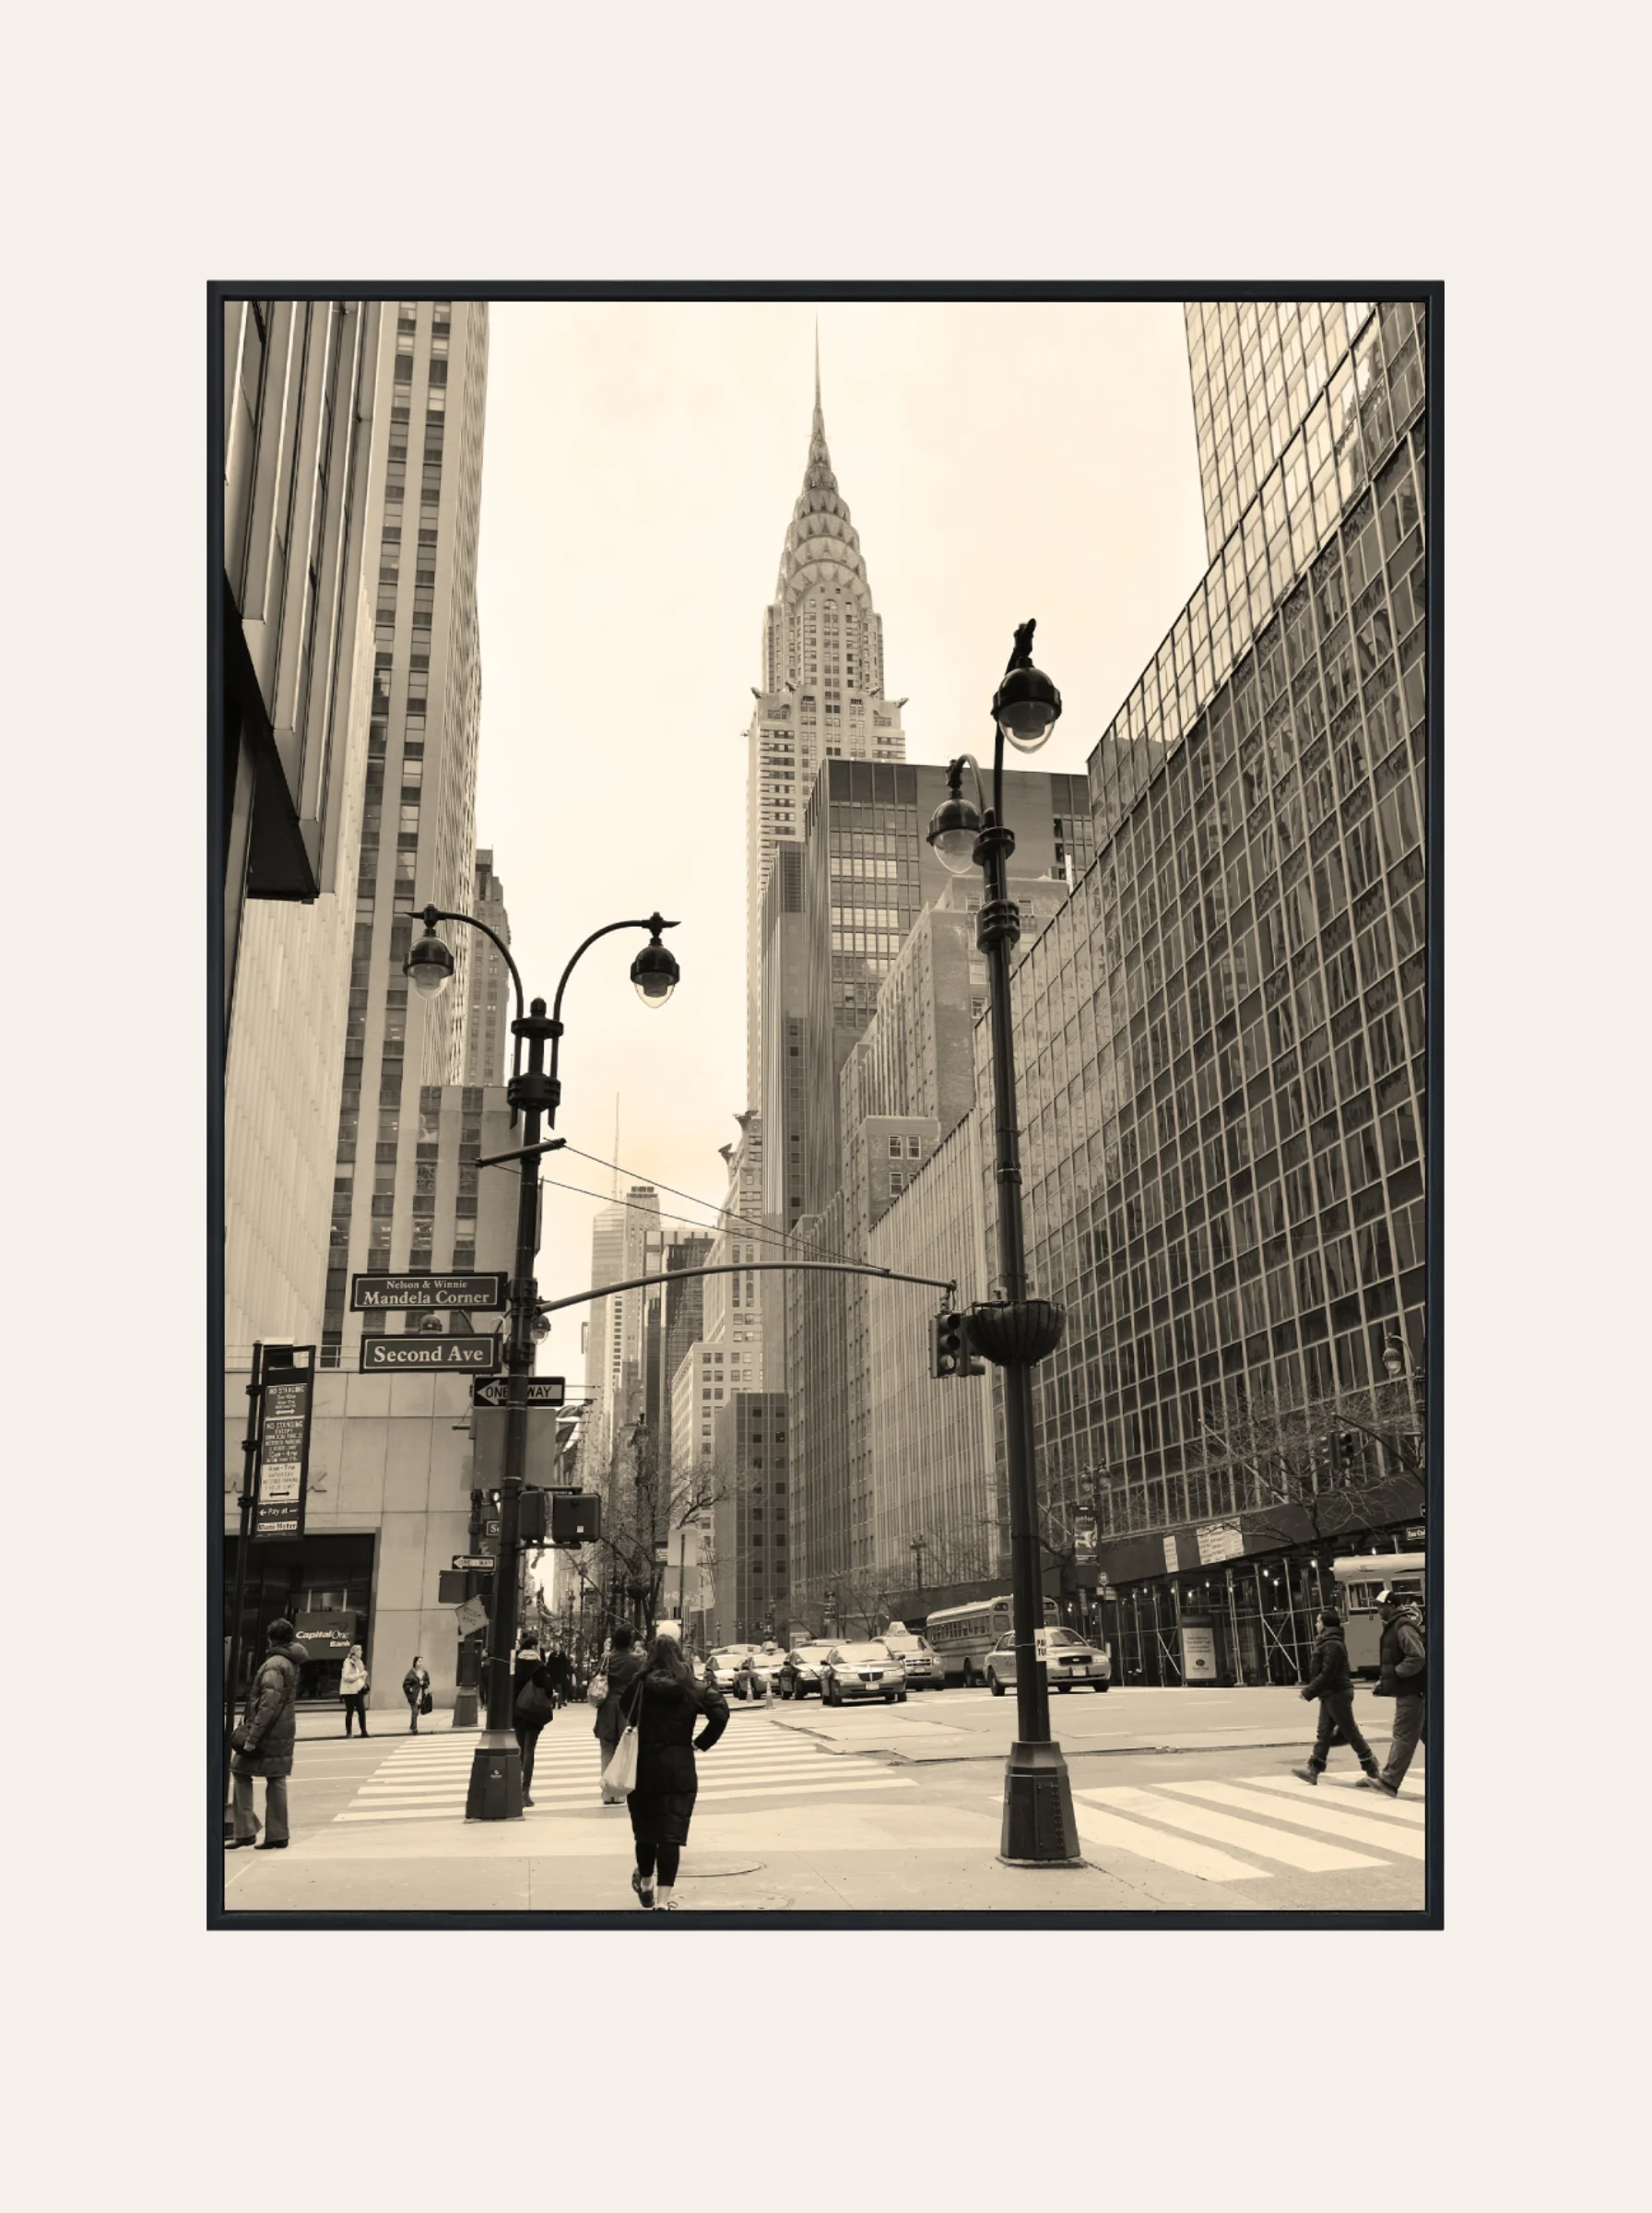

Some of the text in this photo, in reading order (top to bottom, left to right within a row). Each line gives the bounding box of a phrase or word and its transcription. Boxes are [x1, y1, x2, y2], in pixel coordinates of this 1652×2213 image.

[386, 1281, 419, 1289] Nelson
[434, 1280, 467, 1289] Winnie
[363, 1290, 490, 1306] Mandela Corner
[373, 1345, 484, 1363] Second Ave
[485, 1383, 551, 1399] ONE WAY
[267, 1508, 279, 1517] Pay
